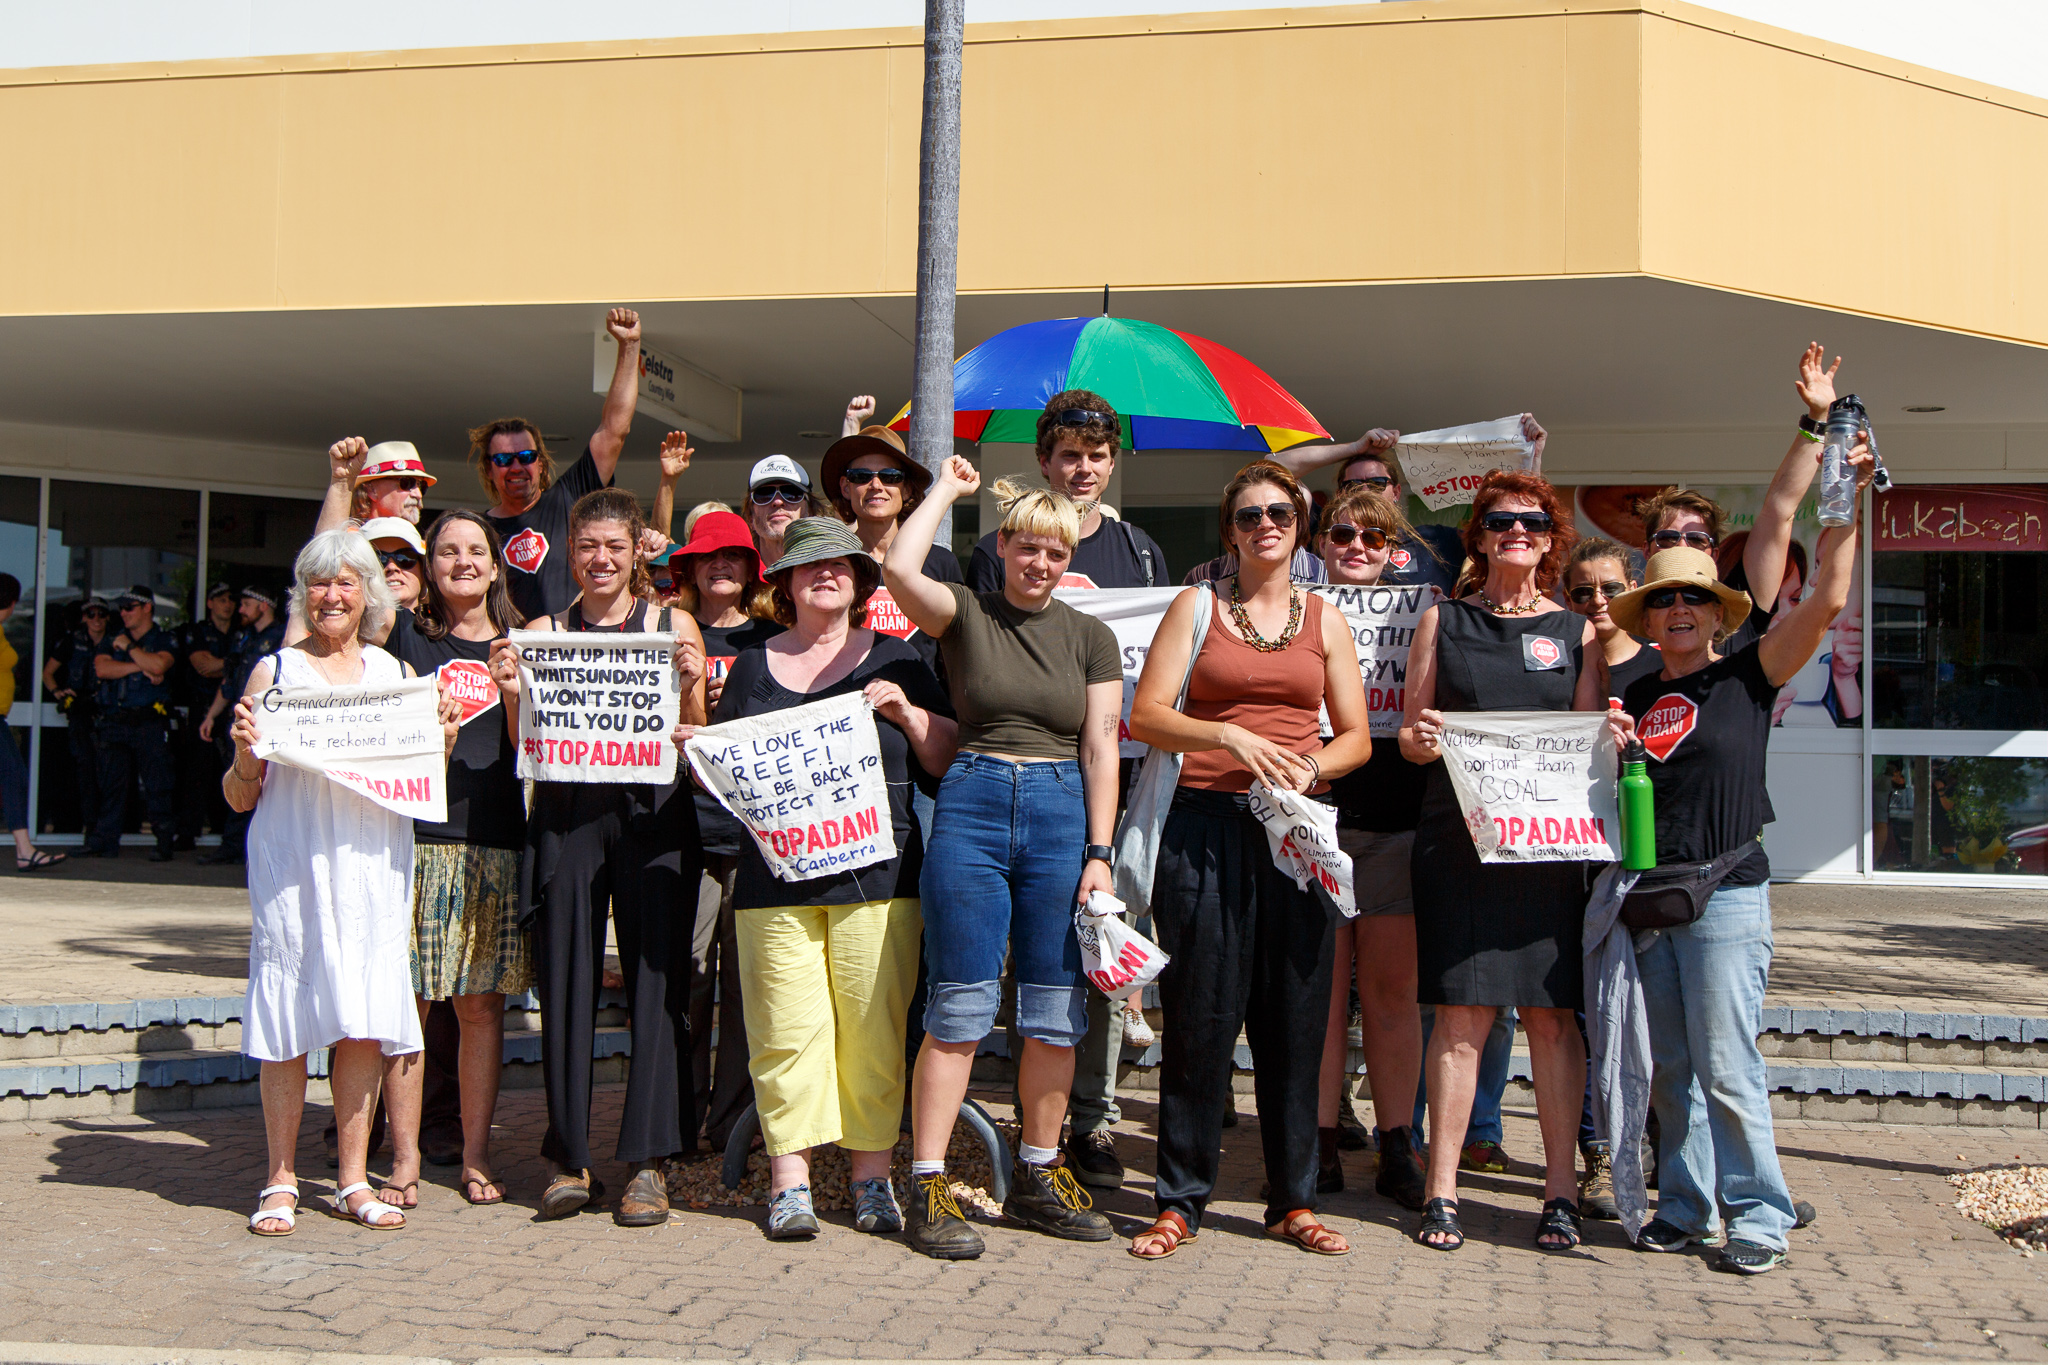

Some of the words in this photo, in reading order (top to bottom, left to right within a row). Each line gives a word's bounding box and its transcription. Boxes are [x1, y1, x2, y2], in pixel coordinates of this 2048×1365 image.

[639, 349, 674, 384] Telstra
[1406, 443, 1440, 460] My
[1456, 434, 1520, 451] Home
[1409, 461, 1437, 477] Our
[1463, 450, 1506, 459] Planet
[1429, 466, 1457, 480] Join
[1499, 461, 1514, 471] to
[511, 536, 538, 551] #STOP
[515, 546, 541, 564] ADANI
[870, 616, 908, 631] ADANI
[522, 648, 576, 663] GREW
[580, 648, 605, 663] UP
[609, 649, 627, 663] IN
[631, 649, 669, 665] THE
[449, 669, 491, 688] #STOP
[531, 668, 661, 686] WHITSUNDAYS
[450, 684, 488, 702] ADANI
[529, 688, 534, 703] I
[539, 689, 604, 707] WON'T
[608, 691, 662, 710] STOP
[297, 715, 320, 726] ARE
[325, 714, 334, 723] A
[339, 710, 383, 723] force
[531, 710, 580, 729] UNTIL
[584, 713, 627, 731] YOU
[633, 714, 664, 733] DO
[1646, 706, 1687, 724] #STOP
[1643, 720, 1684, 739] ADANI
[268, 738, 288, 750] to
[397, 731, 426, 745] with
[699, 744, 743, 766] WE
[752, 730, 805, 757] LOVE
[813, 716, 853, 739] THE
[1439, 729, 1489, 748] Water
[1506, 731, 1521, 749] is
[1536, 736, 1593, 753] more
[524, 737, 661, 766] #STOPADANI
[1535, 754, 1576, 775] than
[773, 779, 796, 796] BE
[811, 764, 853, 787] BACK
[858, 755, 878, 773] TO
[831, 784, 860, 803] IT
[1479, 776, 1559, 804] COAL
[1495, 846, 1518, 858] from
[1530, 845, 1593, 858] Townsville
